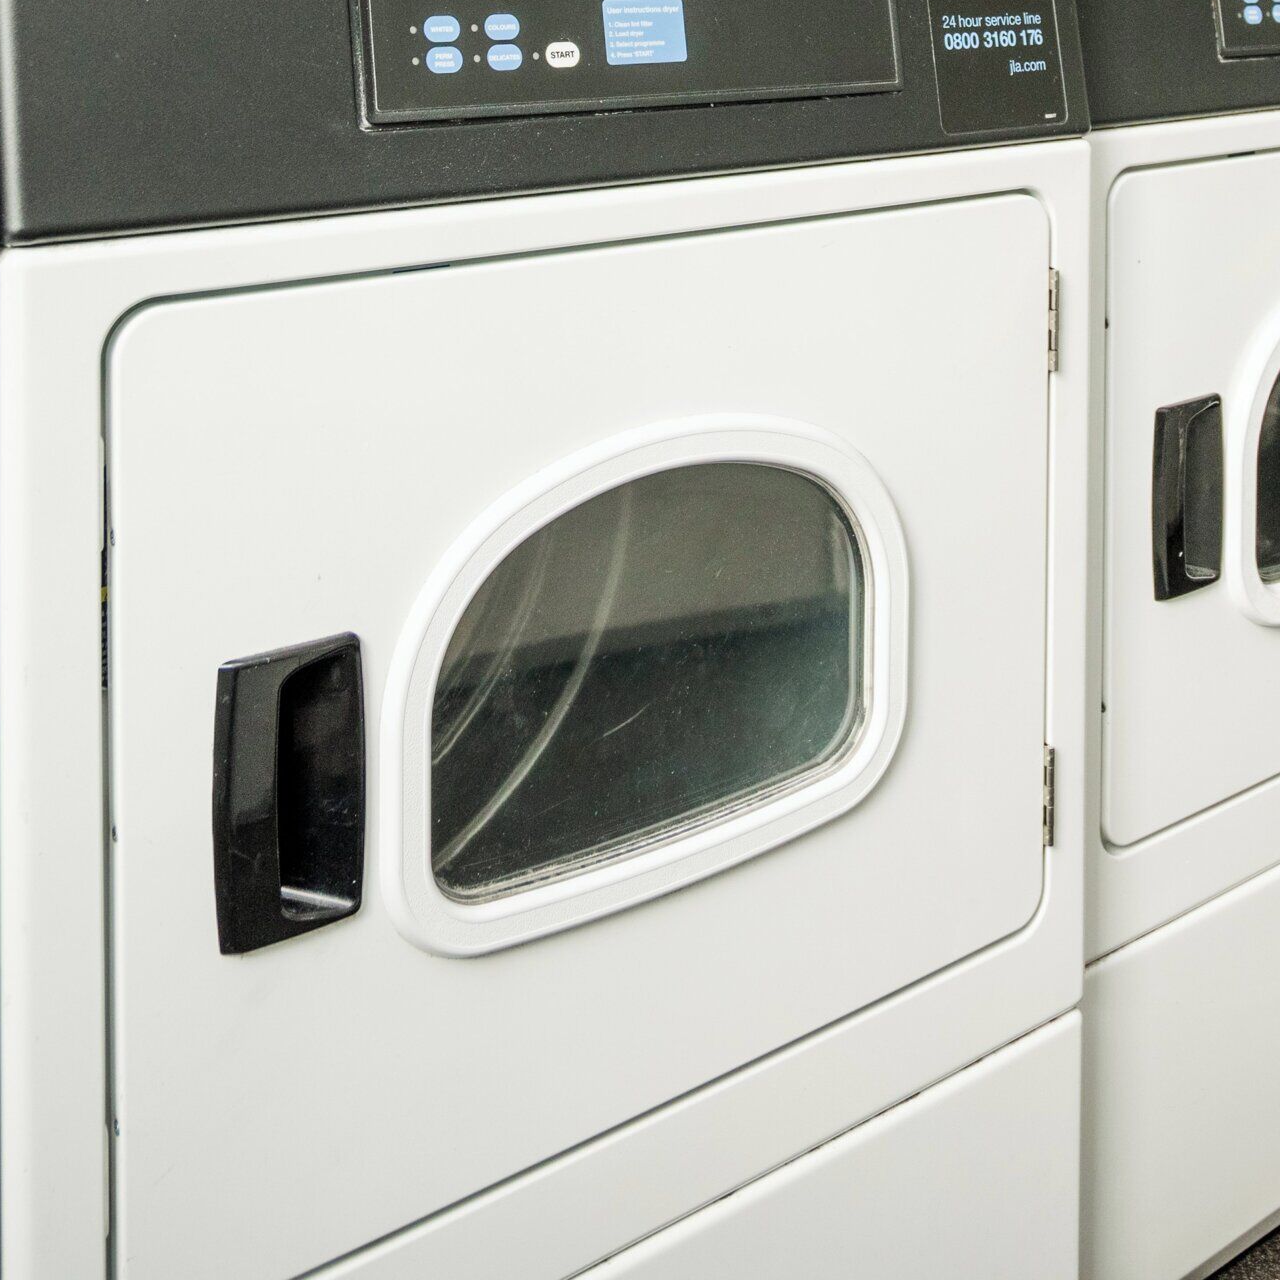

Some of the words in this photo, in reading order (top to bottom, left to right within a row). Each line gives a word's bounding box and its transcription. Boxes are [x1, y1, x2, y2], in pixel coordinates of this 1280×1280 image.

[623, 6, 661, 14] instructions
[943, 16, 957, 28] 24
[958, 14, 982, 28] hour
[984, 13, 1022, 26] service
[1023, 12, 1042, 25] line
[944, 32, 980, 51] 0800
[983, 30, 1017, 48] 3160
[1019, 28, 1043, 46] 176
[550, 51, 575, 59] START
[1009, 60, 1047, 76] jla.com
